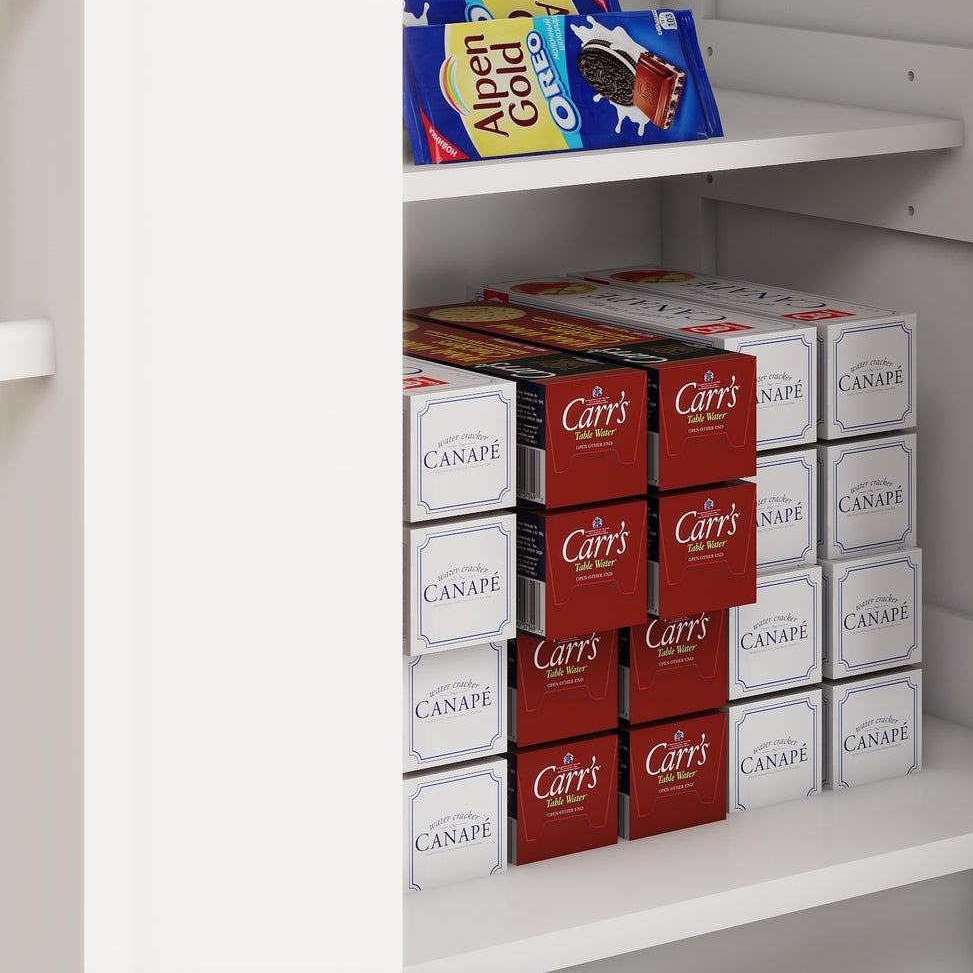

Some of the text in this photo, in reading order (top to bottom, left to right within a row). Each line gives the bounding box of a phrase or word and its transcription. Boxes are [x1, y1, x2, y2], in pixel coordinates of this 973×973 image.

[464, 34, 510, 138] Alpen
[489, 41, 539, 128] Gold
[526, 31, 579, 132] OREO
[428, 125, 459, 158] НОВИНКА
[769, 372, 793, 381] cracker
[838, 365, 904, 392] CANAPÉ
[850, 357, 894, 373] water cracker
[675, 375, 739, 415] Carr's
[756, 379, 803, 405] NAPÉ
[562, 390, 629, 431] Carr's
[687, 411, 727, 424] Table Water
[437, 431, 489, 448] water cracker
[575, 428, 616, 441] Table Water
[423, 439, 501, 469] CANAPÉ
[769, 493, 793, 504] cracker
[838, 485, 904, 513] CANAPÉ
[850, 477, 894, 494] water cracker
[675, 503, 739, 544] Carr's
[756, 502, 803, 528] NAPÉ
[562, 521, 629, 563] Carr's
[687, 540, 727, 553] Table Water
[438, 563, 488, 581] water cracker
[574, 559, 616, 572] Table Water
[423, 571, 501, 603] CANAPÉ
[753, 613, 798, 630] water cracker
[843, 601, 909, 631] CANAPÉ
[740, 620, 808, 650] CANAPÉ
[657, 644, 697, 658] Table Water
[415, 686, 492, 719] CANAPÉ
[844, 721, 909, 753] CANAPÉ
[856, 714, 899, 733] water cracker
[645, 733, 709, 776] Carr's
[740, 743, 808, 775] CANAPÉ
[533, 755, 600, 799] Carr's
[657, 770, 697, 785] Table Water
[546, 794, 588, 809] Table Water
[429, 810, 480, 830] water cracker
[415, 817, 492, 852] CANAPÉ
